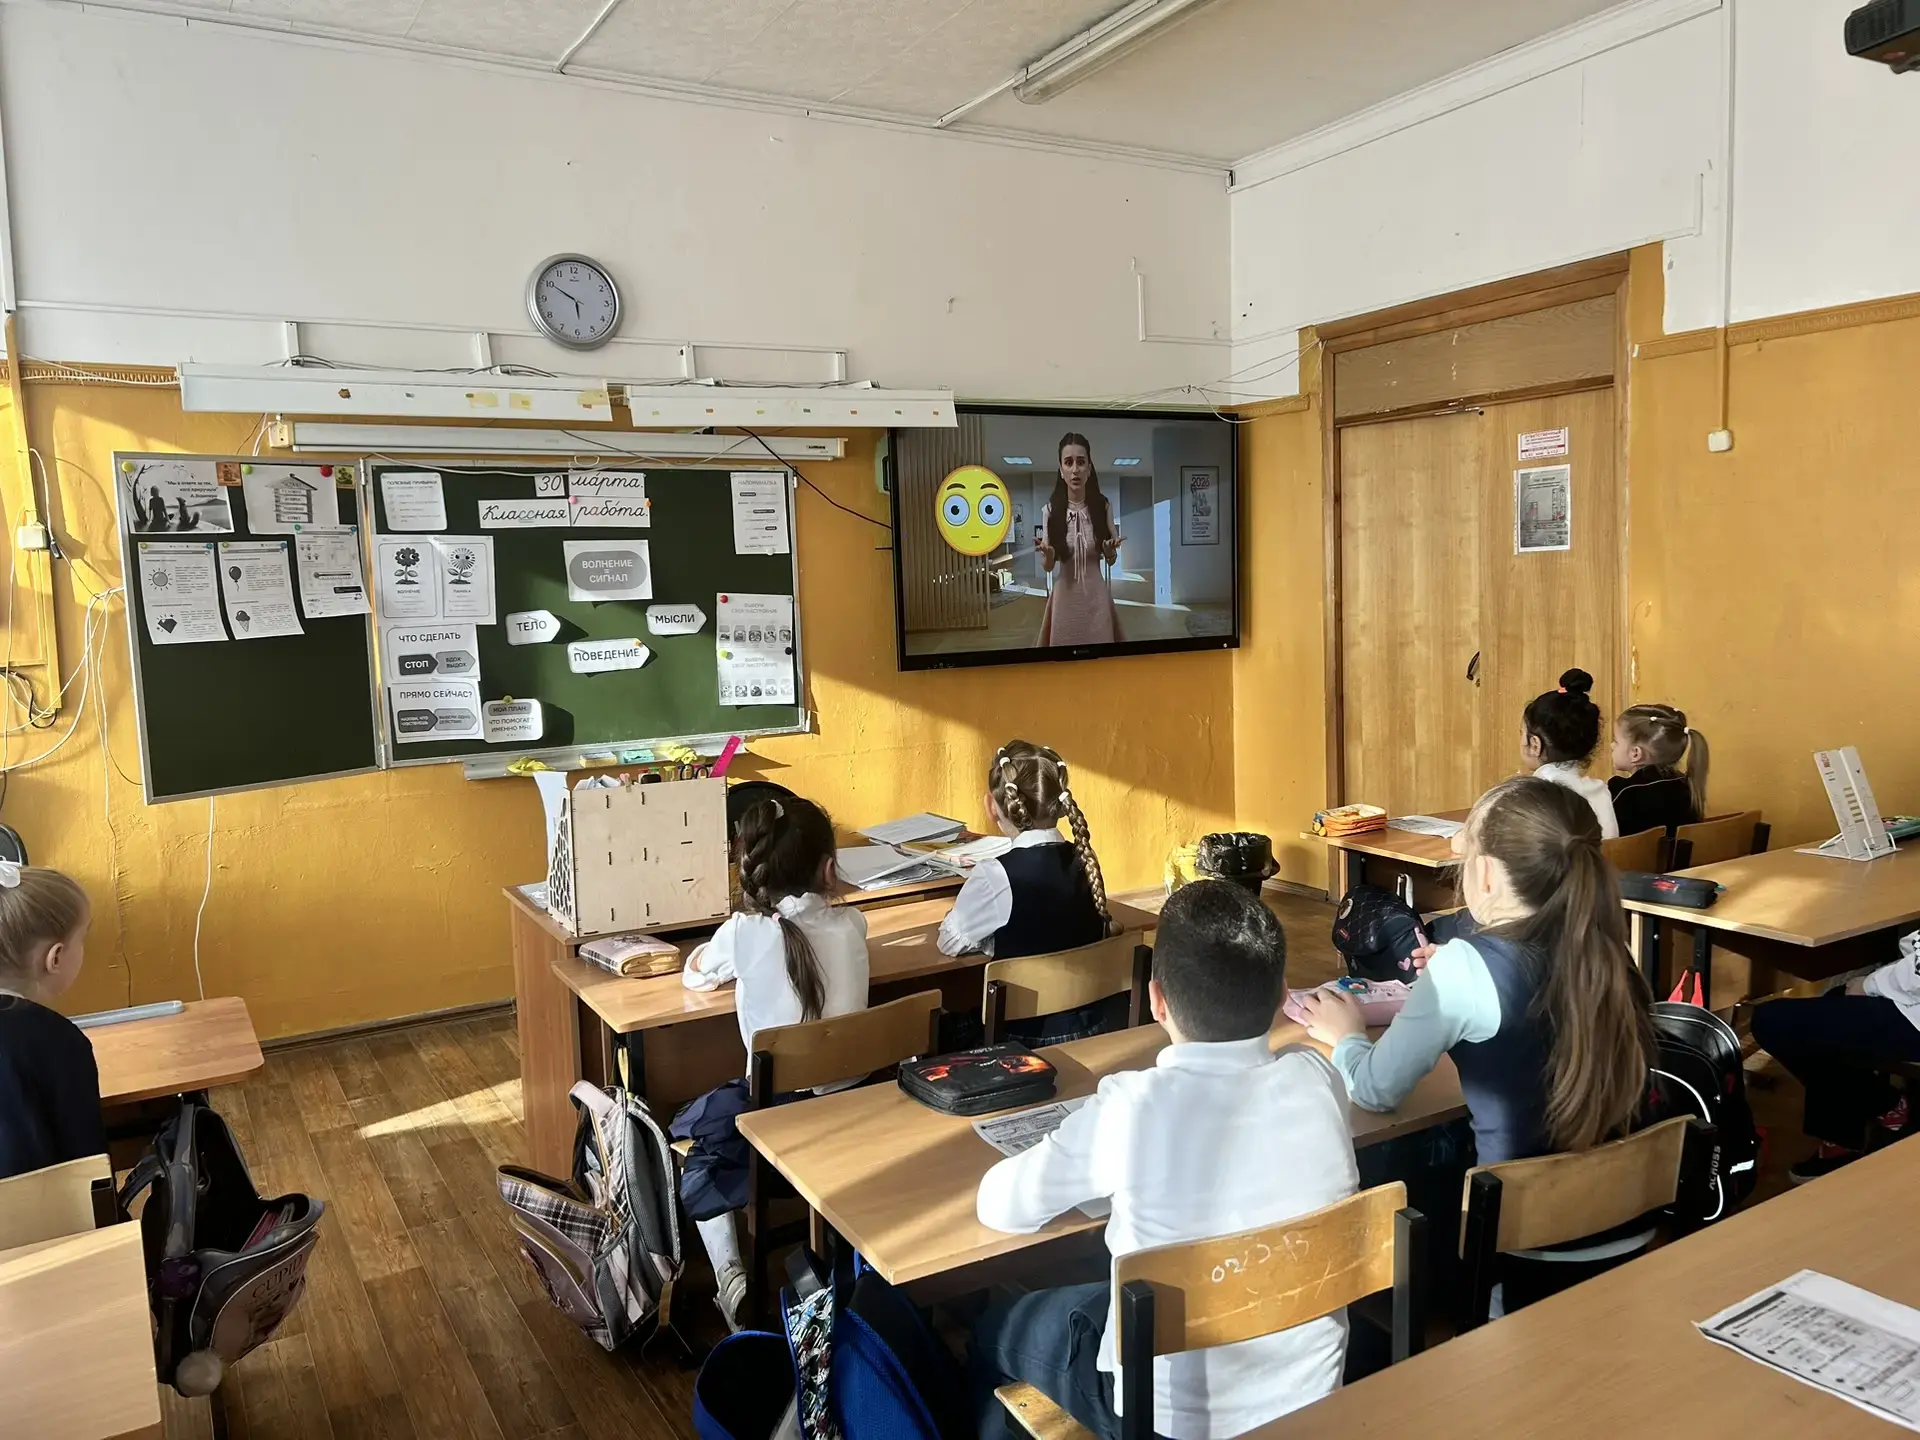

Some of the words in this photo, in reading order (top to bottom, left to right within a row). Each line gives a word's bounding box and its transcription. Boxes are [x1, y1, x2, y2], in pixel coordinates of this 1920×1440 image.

[556, 270, 562, 278] 11
[570, 266, 578, 274] 12
[546, 280, 554, 288] 10
[604, 300, 610, 308] 3
[574, 328, 580, 336] 6
[538, 475, 562, 491] 30
[1192, 477, 1210, 487] 2026
[482, 505, 568, 520] Классная
[582, 559, 633, 569] ВОЛНЕНИЕ
[589, 574, 628, 583] СИГНАЛ
[655, 614, 695, 624] МЫСЛИ
[516, 620, 547, 632] ТЕЛО
[398, 634, 417, 642] ЧТО
[420, 633, 461, 642] СДЕЛАТЬ
[574, 648, 640, 662] ПОВЕДЕНИЕ
[405, 661, 429, 669] СТОП
[400, 691, 431, 699] ПРЯМО
[433, 689, 472, 698] СЕЙЧАС?
[252, 1254, 303, 1298] CUPID
